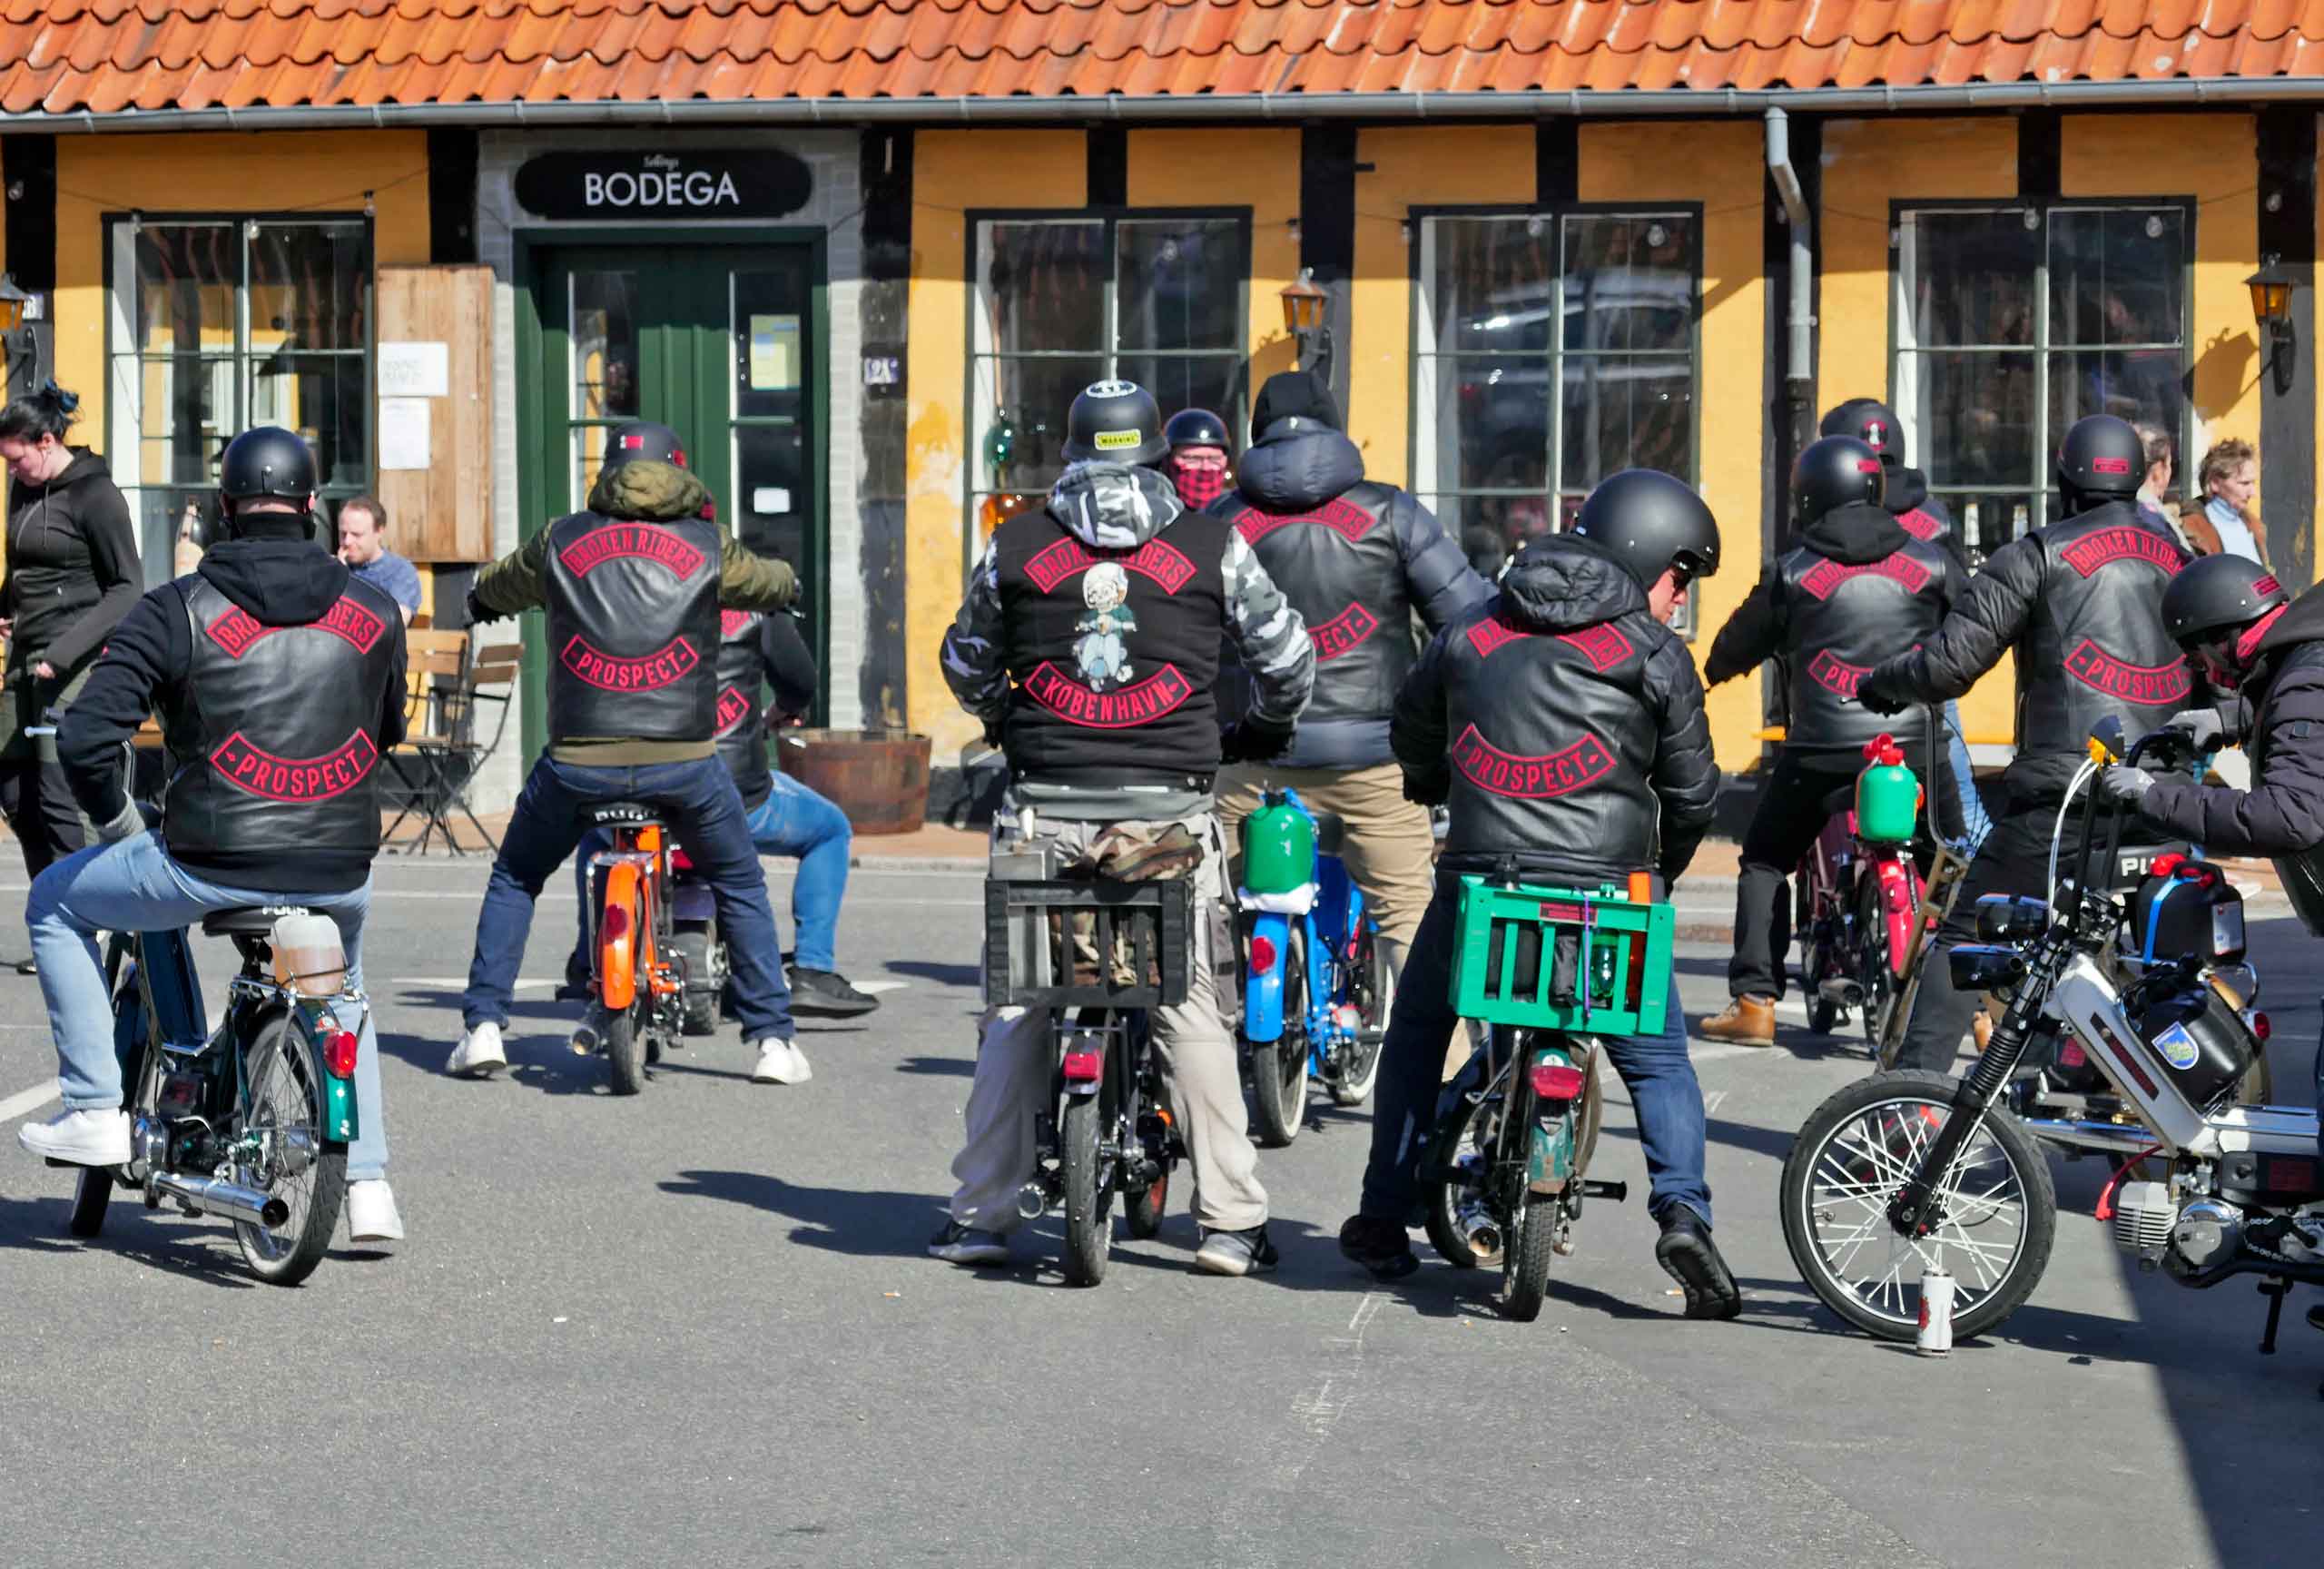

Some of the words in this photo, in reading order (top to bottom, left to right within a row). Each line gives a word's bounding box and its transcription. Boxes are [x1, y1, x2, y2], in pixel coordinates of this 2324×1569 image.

[584, 172, 740, 206] BODEGA
[567, 529, 633, 569] BROKEN
[636, 529, 695, 570] RIDERS
[2069, 531, 2138, 568] BROKEN
[217, 610, 262, 648] BRO
[320, 601, 375, 643] DERS
[576, 651, 682, 687] PROSPECT
[2084, 656, 2185, 698] PROSPECT
[234, 747, 361, 795] PROSPECT
[1465, 745, 1589, 792] PROSPECT
